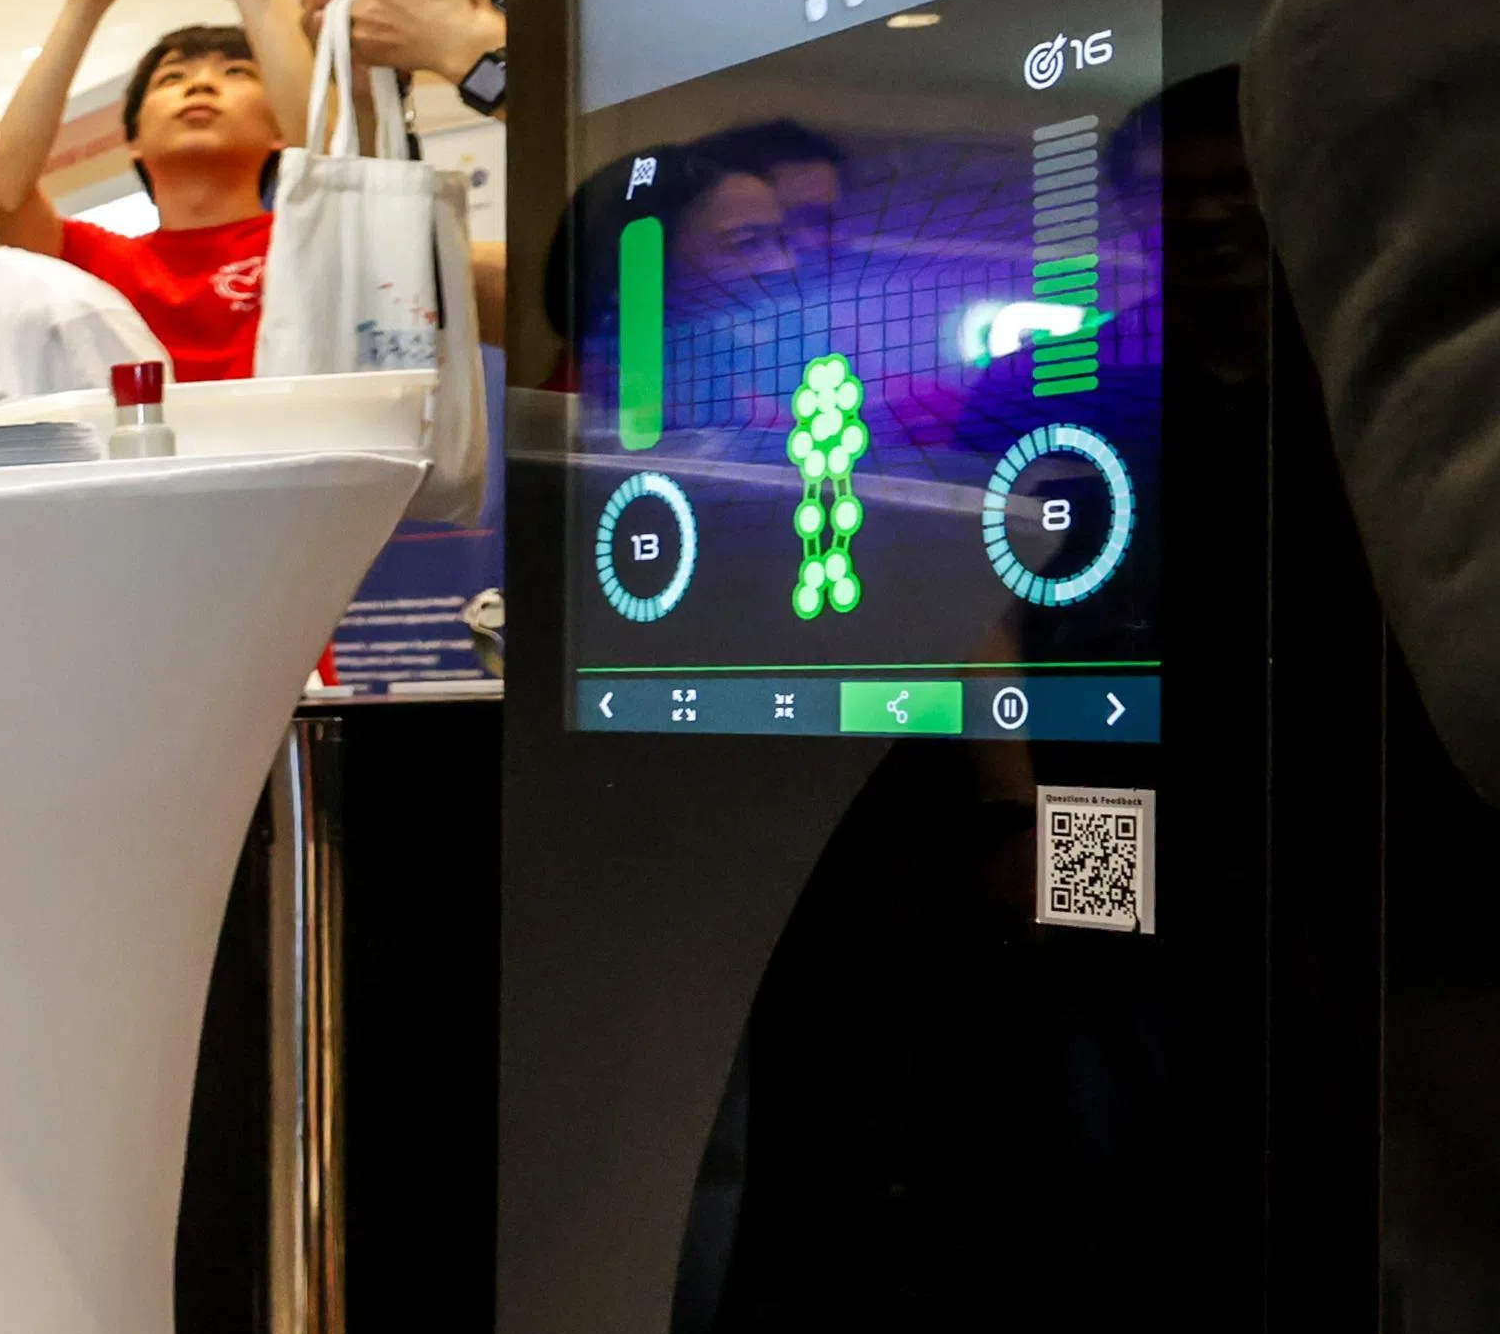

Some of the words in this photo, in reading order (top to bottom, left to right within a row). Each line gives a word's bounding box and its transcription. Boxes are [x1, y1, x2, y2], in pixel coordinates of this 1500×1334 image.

[1070, 29, 1113, 69] 16
[1042, 499, 1071, 531] 8
[631, 533, 660, 561] 13
[1045, 794, 1089, 804] Questions
[1091, 796, 1098, 804] &
[1101, 796, 1143, 806] Feedback
